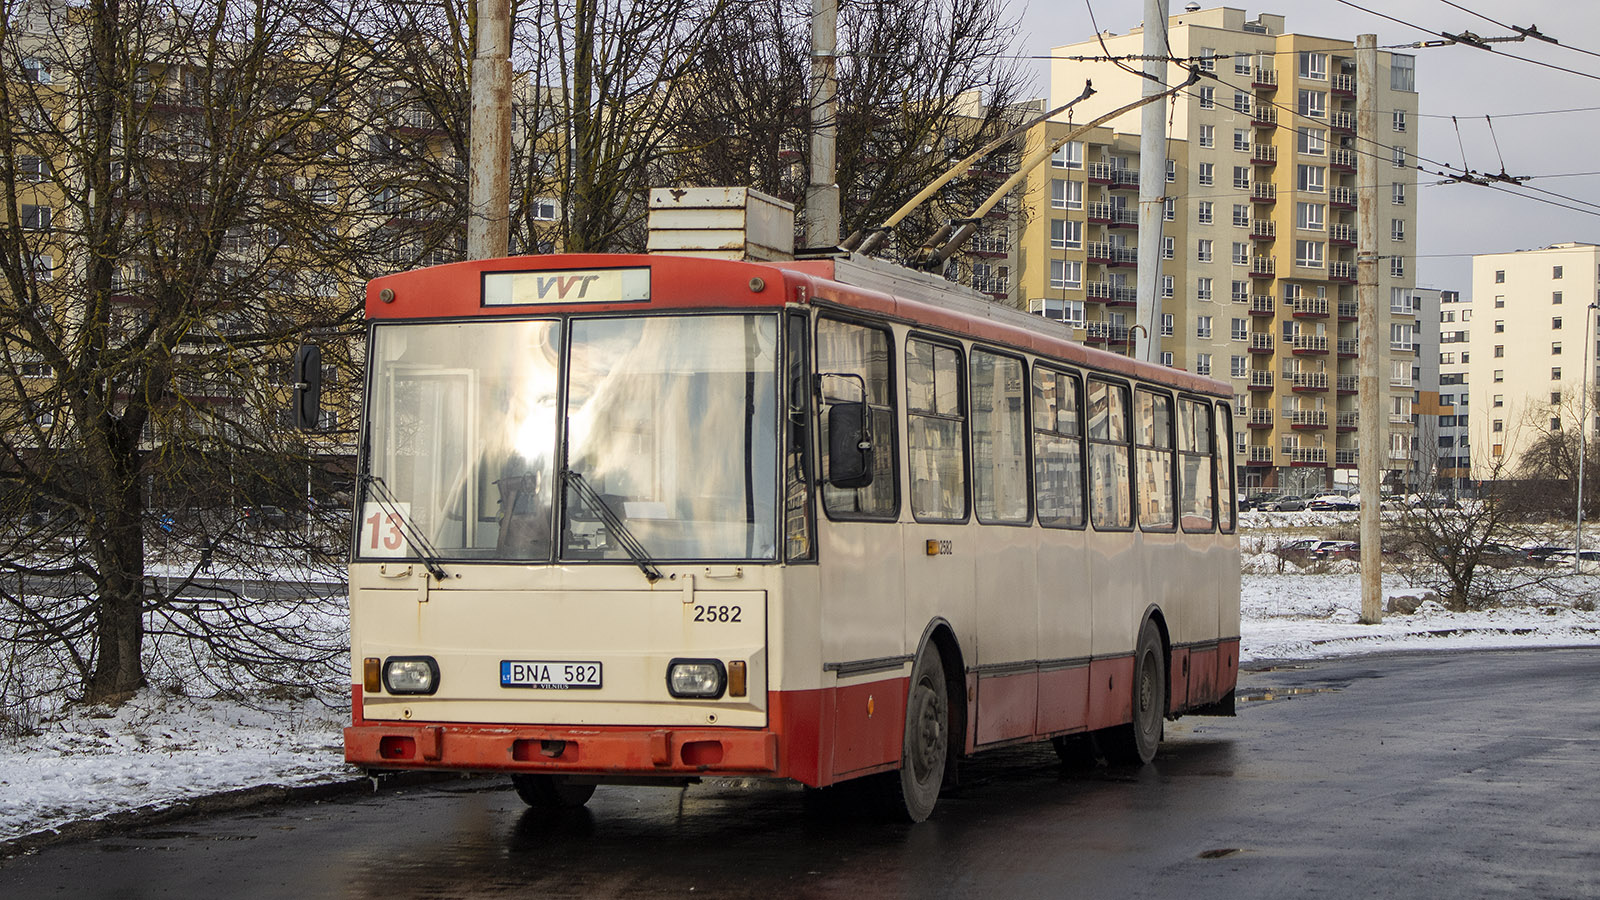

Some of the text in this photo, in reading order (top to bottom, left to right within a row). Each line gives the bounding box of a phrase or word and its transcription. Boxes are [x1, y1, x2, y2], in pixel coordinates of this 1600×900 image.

[366, 512, 403, 550] 13
[939, 540, 952, 555] 2582
[693, 605, 742, 622] 2582
[513, 664, 597, 683] BNA 582
